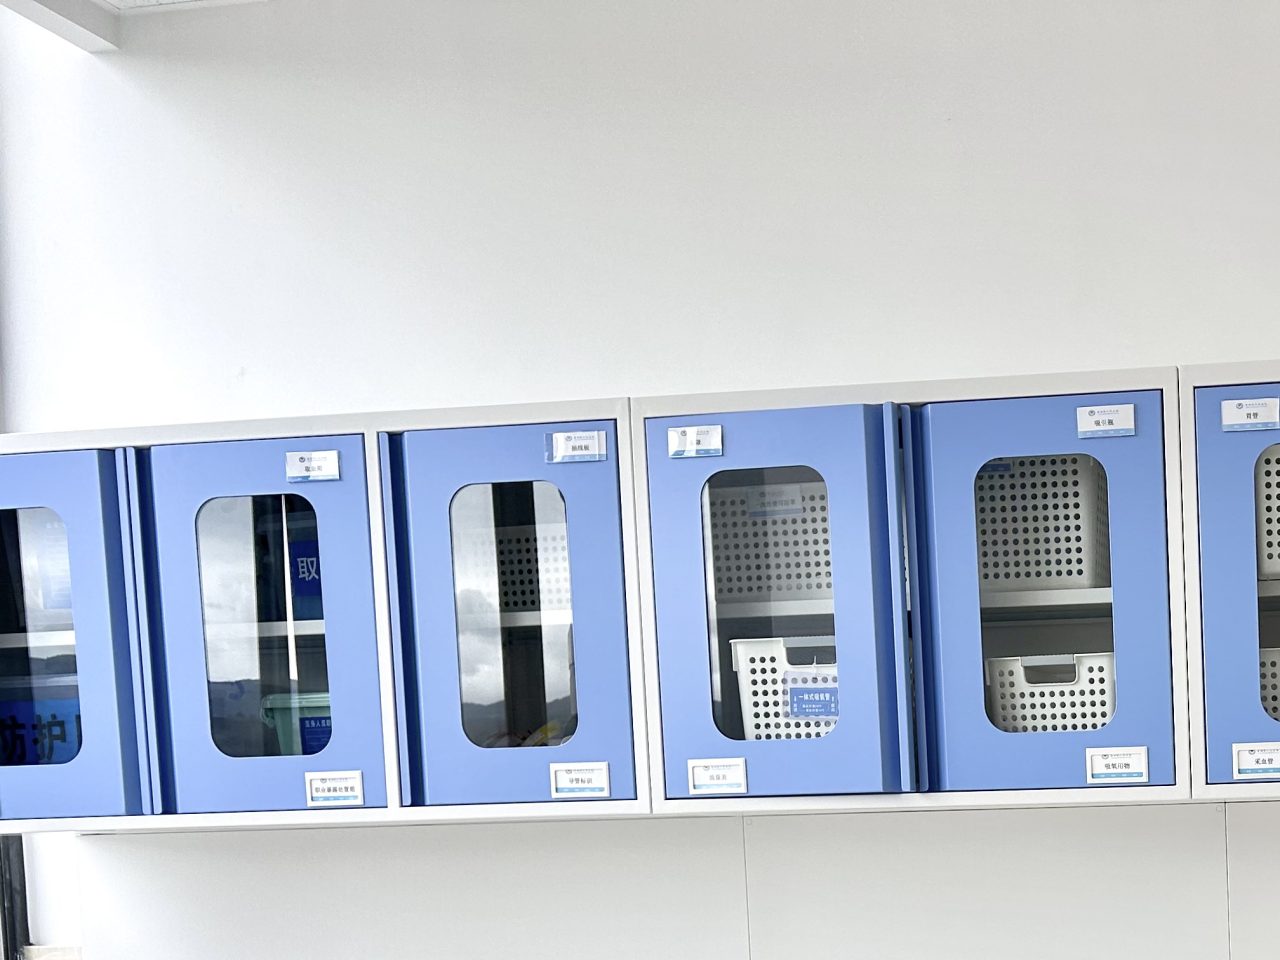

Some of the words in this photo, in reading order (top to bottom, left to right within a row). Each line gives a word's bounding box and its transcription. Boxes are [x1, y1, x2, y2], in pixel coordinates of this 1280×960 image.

[296, 557, 319, 581] 取
[0, 713, 82, 763] 防护
[1104, 762, 1131, 770] 吸氧用物
